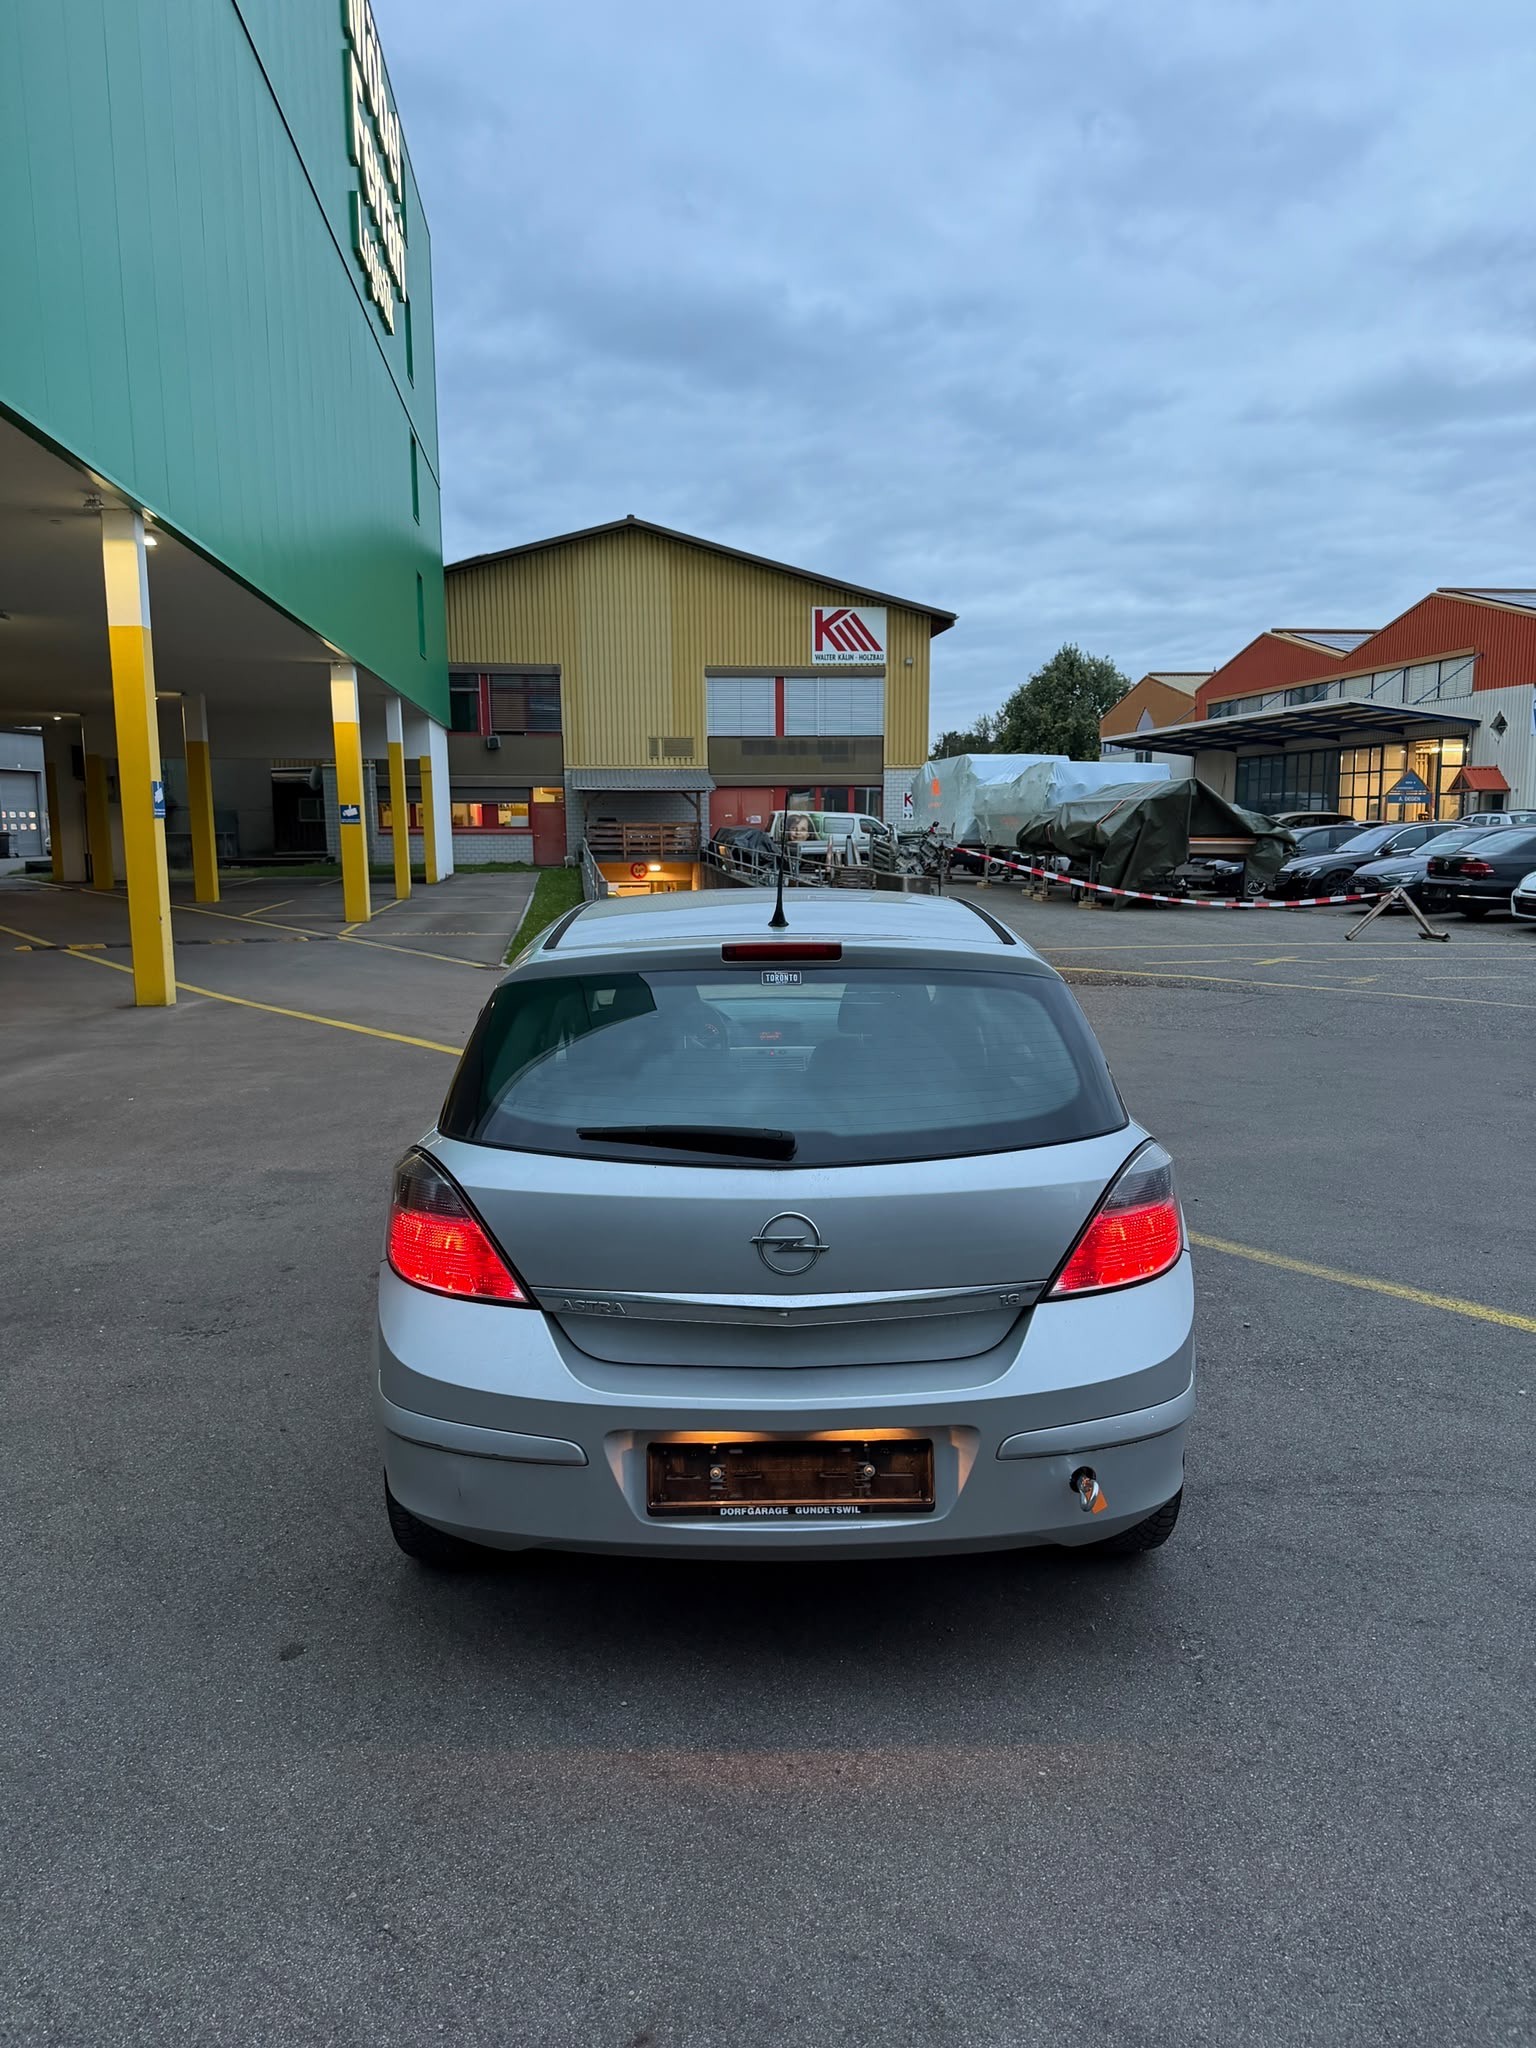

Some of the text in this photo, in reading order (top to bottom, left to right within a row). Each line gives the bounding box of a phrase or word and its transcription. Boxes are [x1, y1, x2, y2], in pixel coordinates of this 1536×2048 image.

[349, 50, 407, 303] Ferrari
[814, 653, 836, 661] WALTER
[837, 653, 854, 661] KÄLIN
[858, 653, 885, 661] HOLZBAU
[765, 974, 798, 982] TORONTO
[560, 1299, 627, 1315] ASTRA
[720, 1506, 861, 1516] DORFGARAGE GUNDETSWIL
